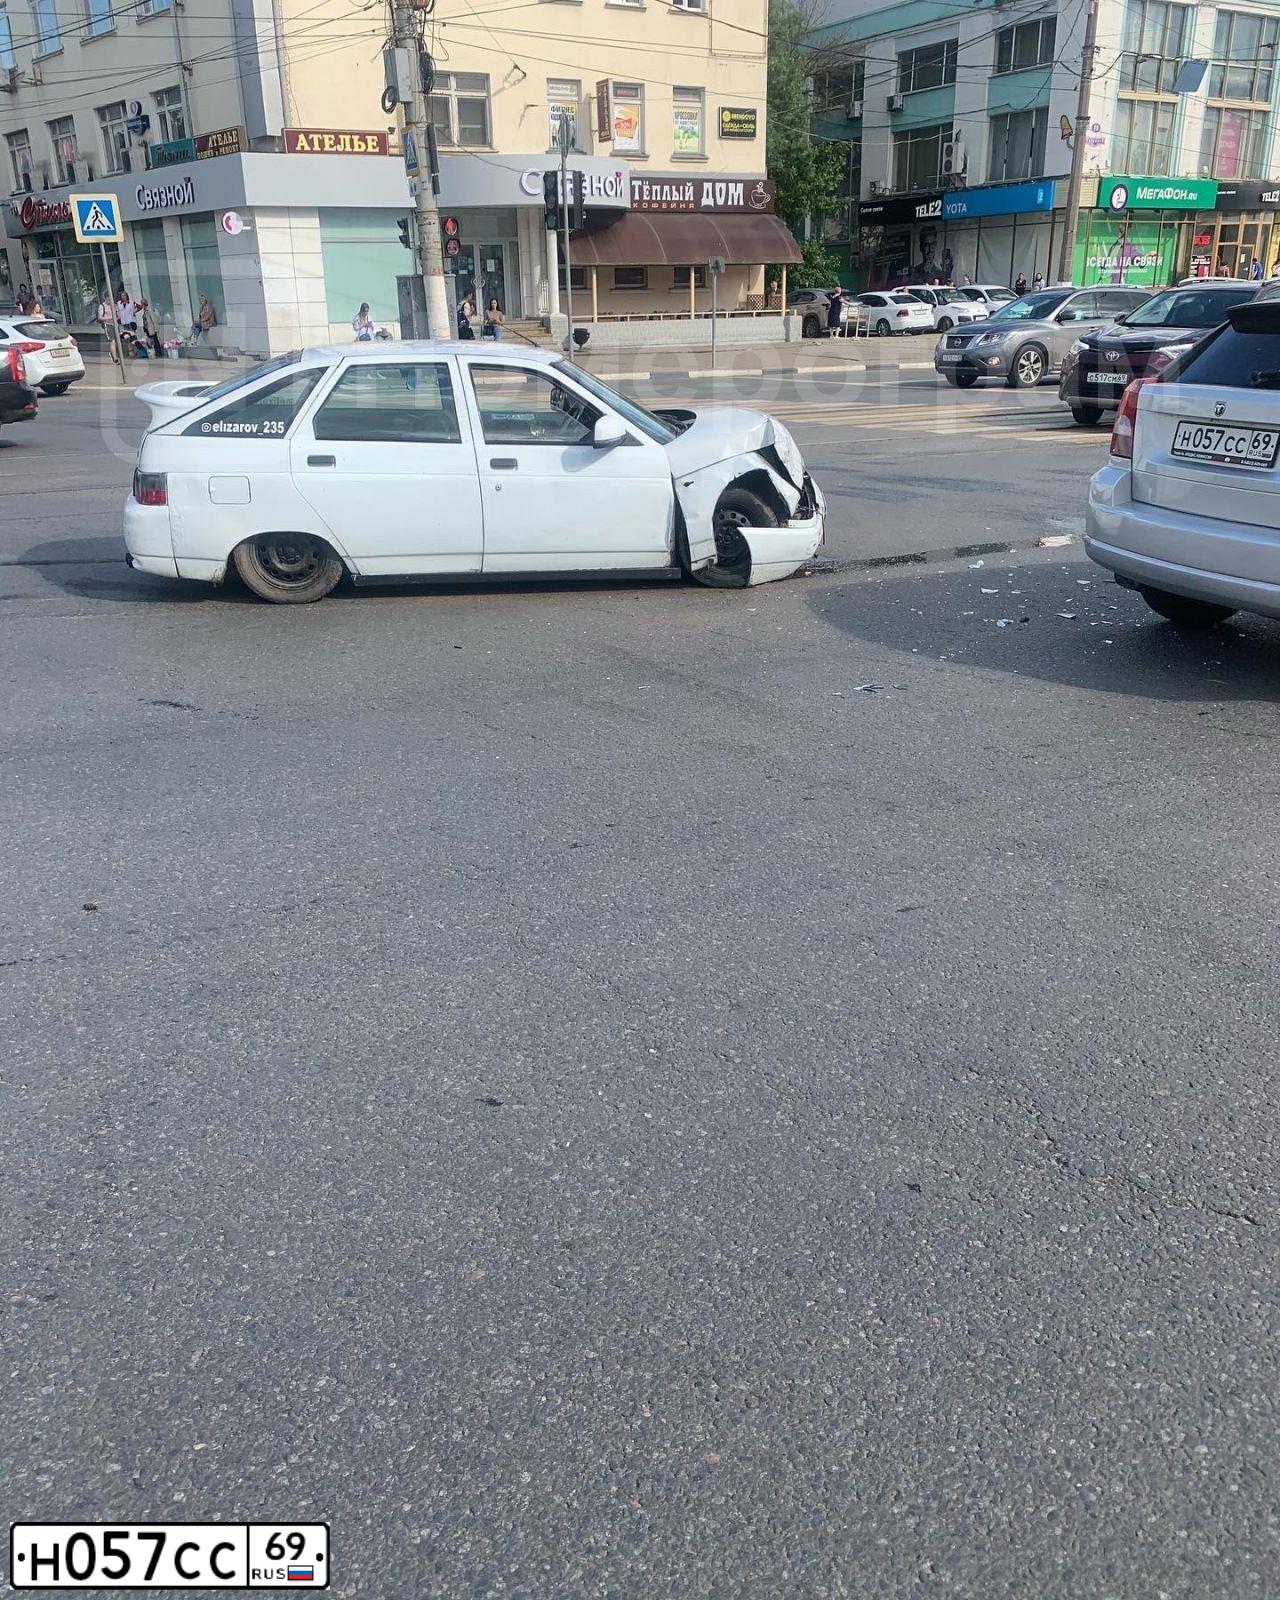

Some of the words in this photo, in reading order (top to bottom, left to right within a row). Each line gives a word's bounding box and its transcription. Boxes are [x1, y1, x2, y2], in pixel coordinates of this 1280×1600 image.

[208, 130, 239, 149] АТЕЛЬЕ
[295, 133, 380, 153] АТЕЛЬЕ
[701, 182, 744, 208] ДОМ
[915, 199, 942, 218] TELE2
[945, 202, 968, 214] YOTA
[1135, 256, 1163, 267] СВЯЗИ
[1180, 427, 1247, 454] Н057СС
[1251, 432, 1273, 451] 69
[1248, 449, 1262, 458] RUS
